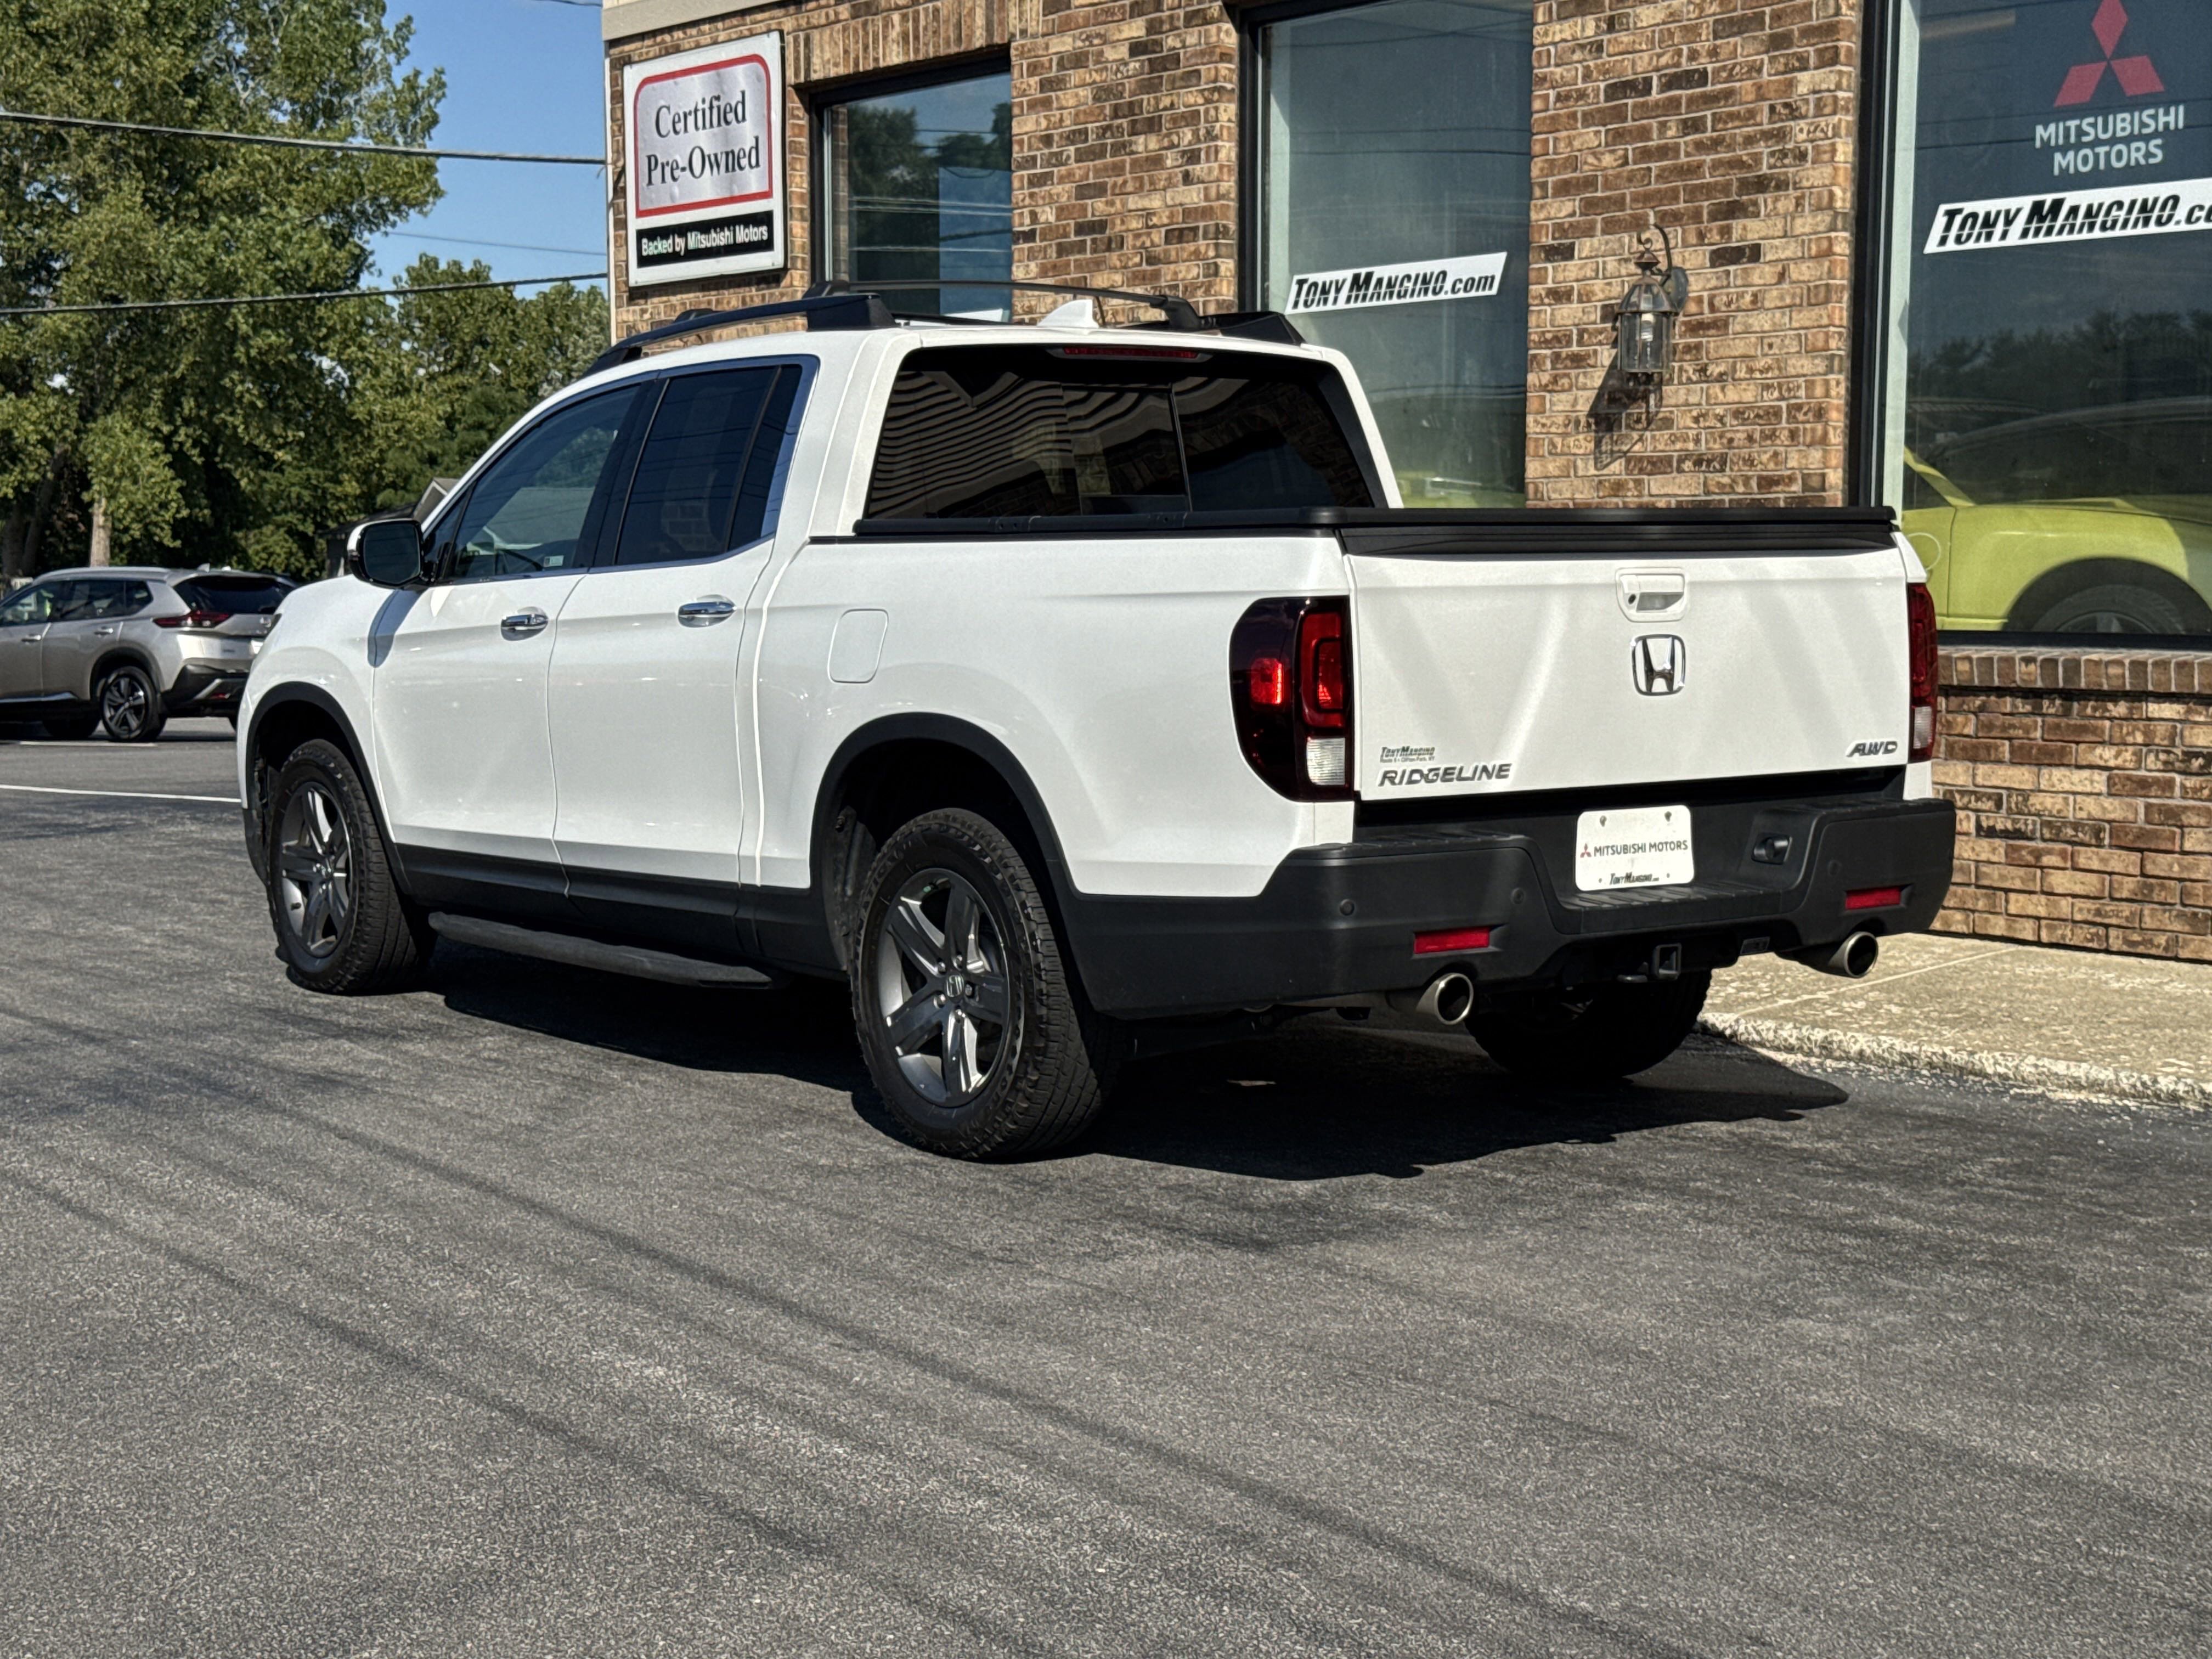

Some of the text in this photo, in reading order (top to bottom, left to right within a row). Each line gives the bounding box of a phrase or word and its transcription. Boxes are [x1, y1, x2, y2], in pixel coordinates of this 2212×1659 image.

[655, 89, 747, 138] Certified
[2035, 104, 2185, 149] MITSUBISHI
[646, 136, 761, 187] Pre-Owned
[2053, 138, 2163, 176] MOTORS
[641, 223, 769, 256] Backed by Mitsubishi Motors
[1846, 740, 1898, 758] AWD
[1378, 763, 1512, 787] RIDGELINE
[1594, 840, 1688, 857] MITSUBISHI MOTORS
